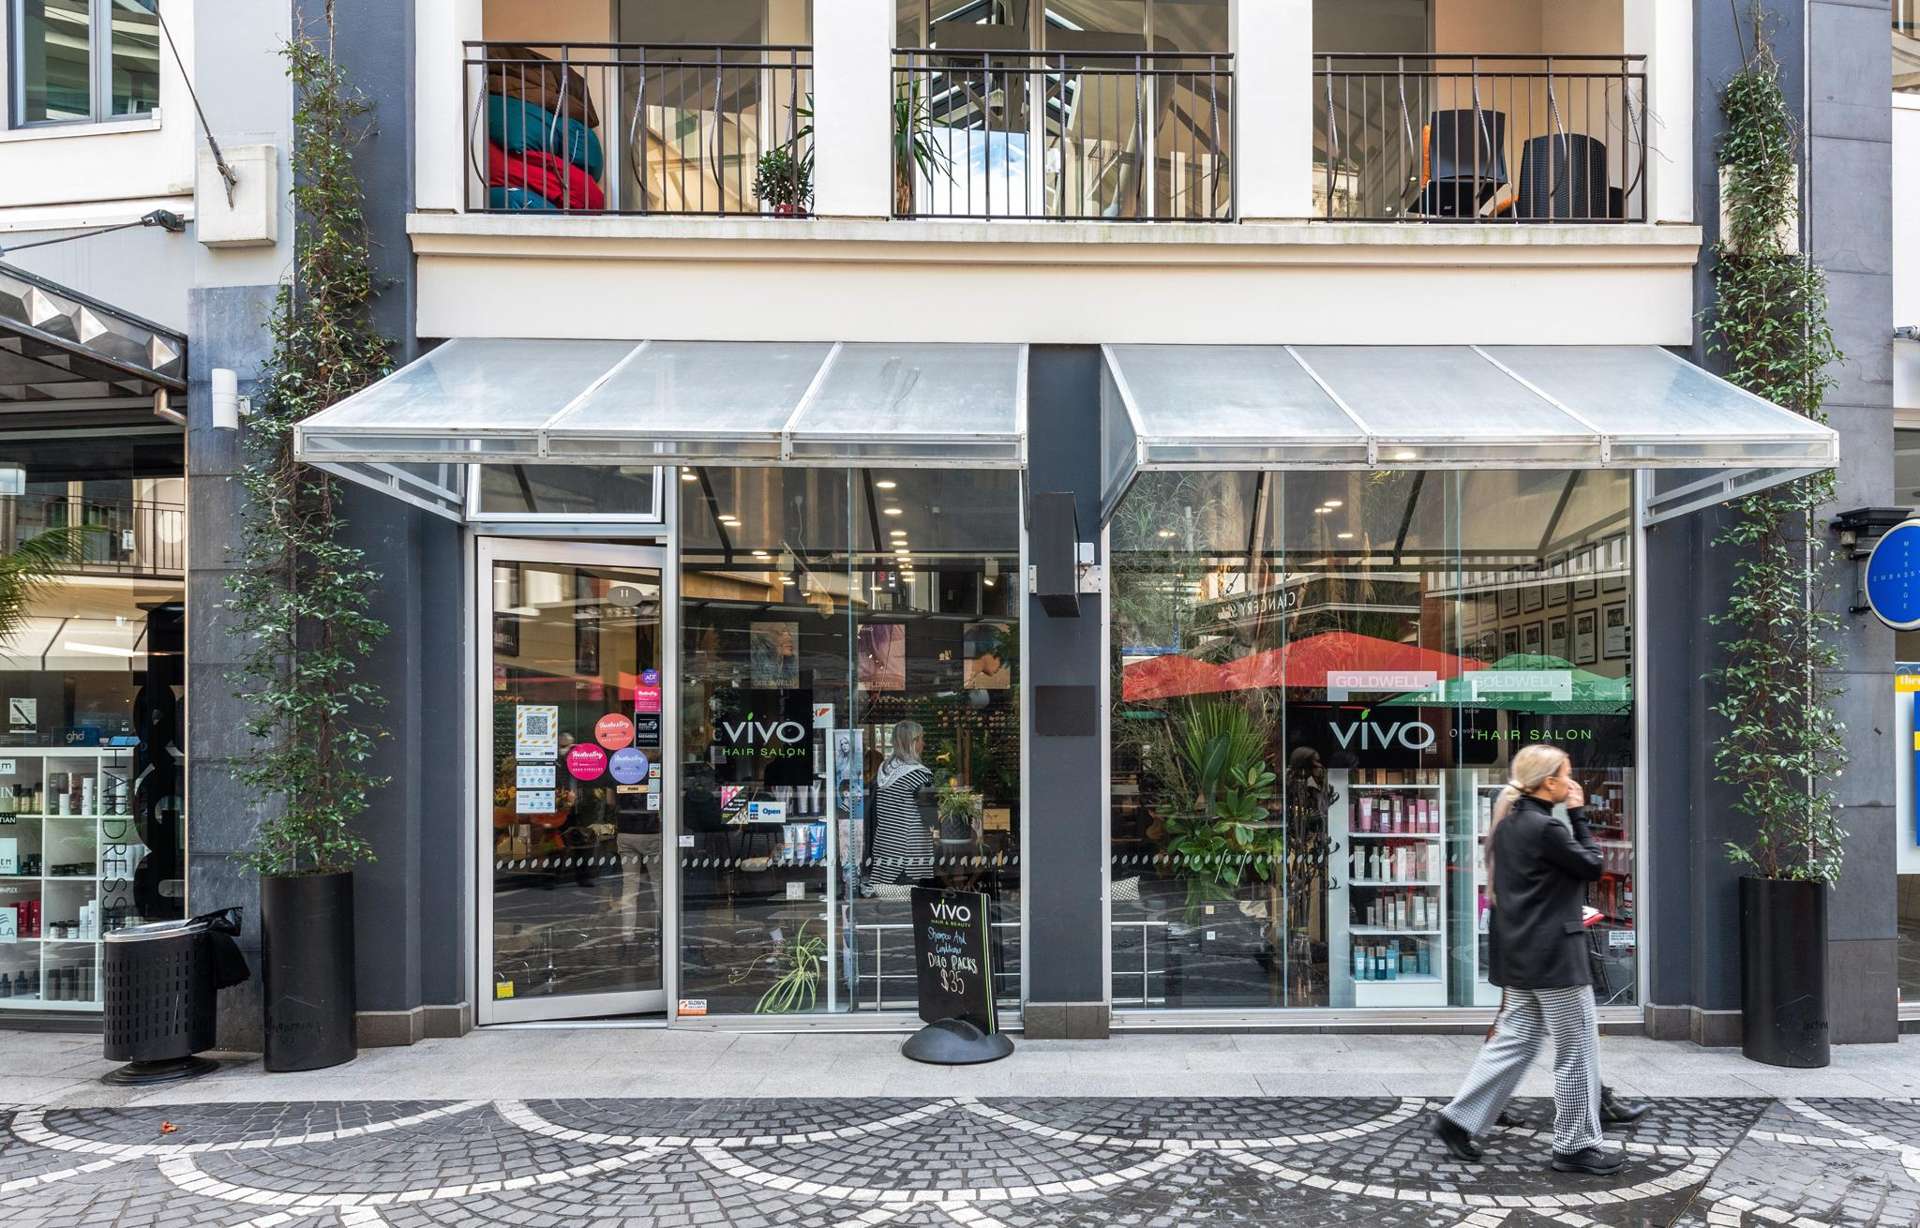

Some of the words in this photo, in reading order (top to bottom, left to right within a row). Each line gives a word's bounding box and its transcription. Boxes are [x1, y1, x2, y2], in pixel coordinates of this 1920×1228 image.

[1335, 675, 1422, 688] GOLDWELL
[65, 731, 85, 744] ghd
[1477, 729, 1521, 740] HAIR
[1529, 729, 1592, 741] SALON
[722, 748, 754, 756] HAIR
[760, 748, 806, 757] SALON
[762, 807, 781, 816] Open
[940, 967, 965, 995] $35
